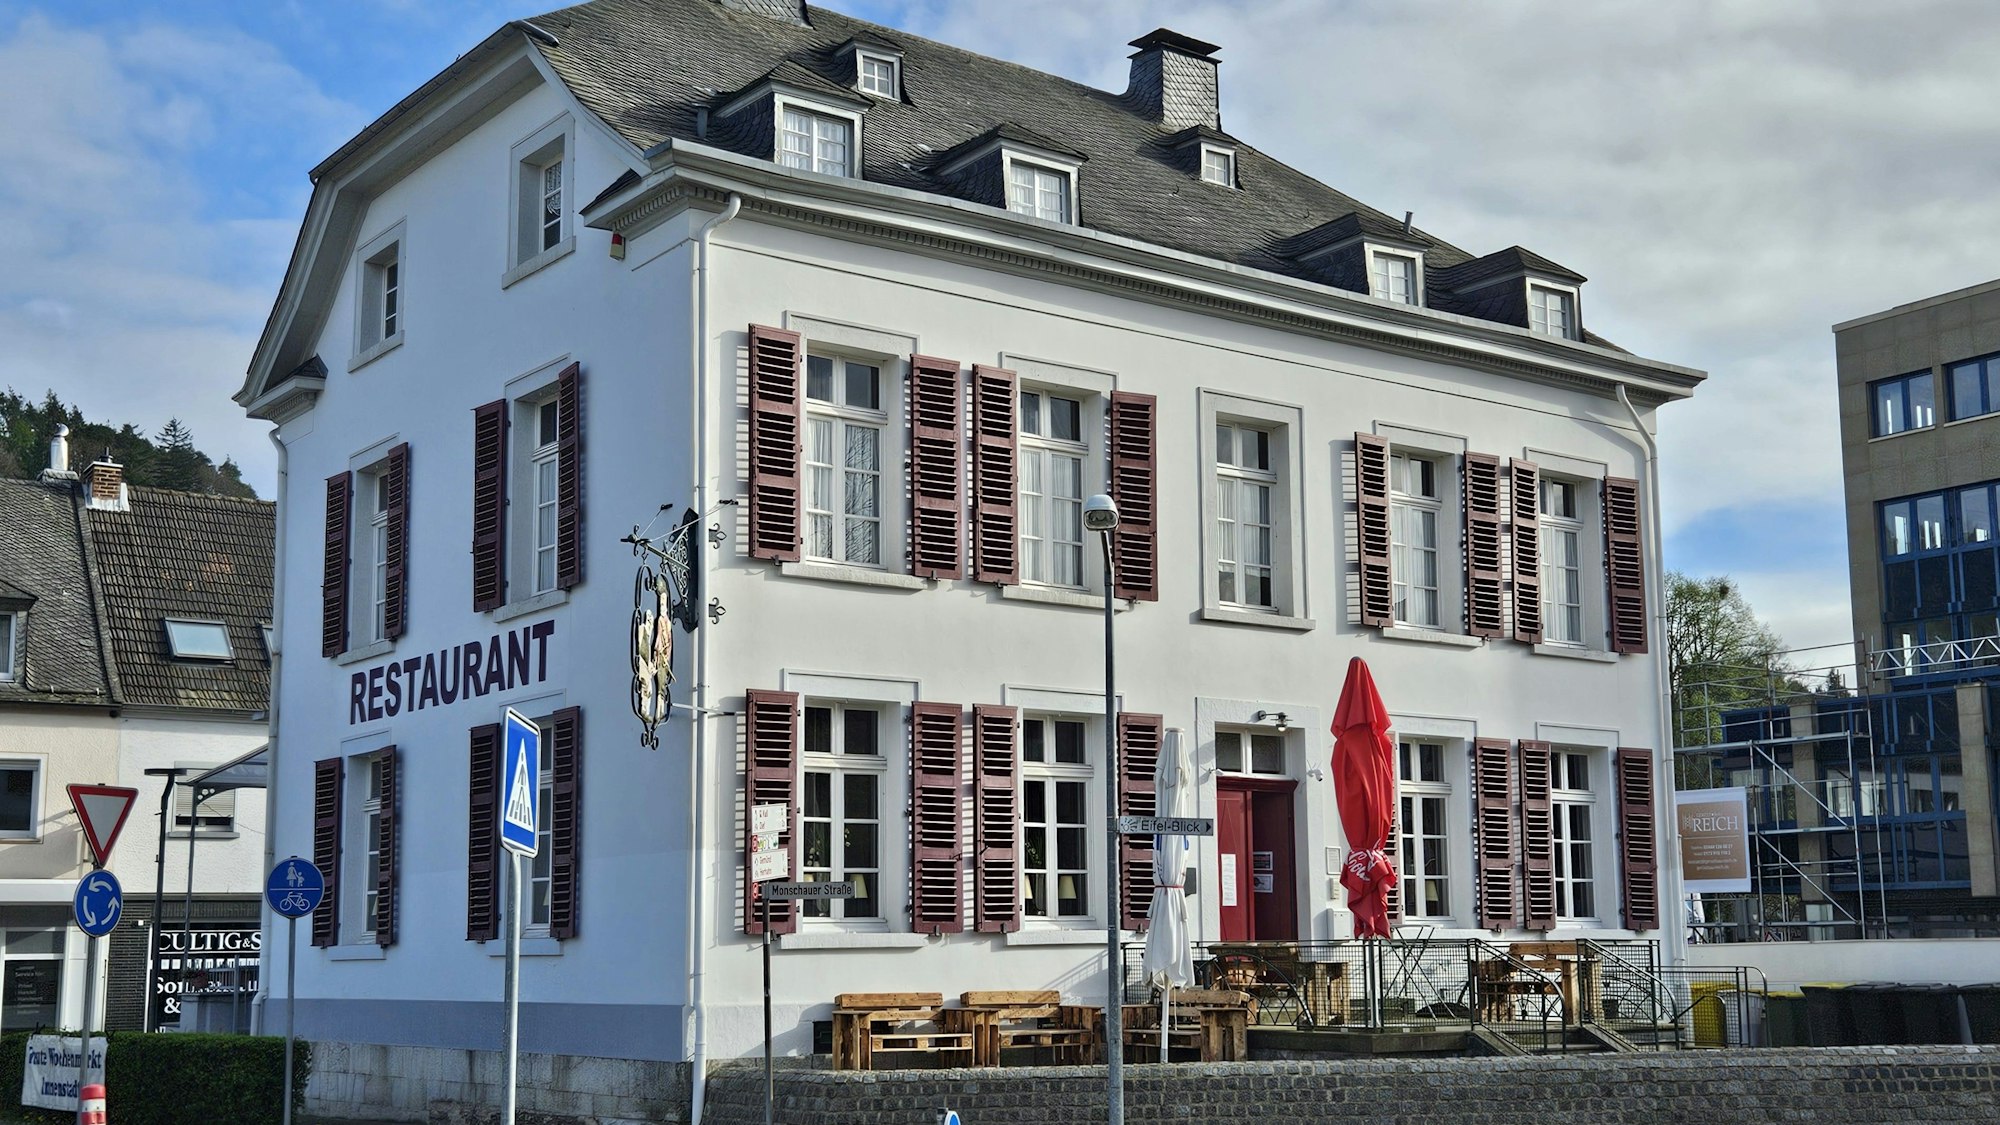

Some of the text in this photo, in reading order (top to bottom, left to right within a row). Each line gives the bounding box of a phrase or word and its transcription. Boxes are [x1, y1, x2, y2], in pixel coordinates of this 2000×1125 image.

[350, 619, 555, 725] RESTAURANT
[1141, 820, 1200, 832] Eifel-Blick
[1692, 815, 1738, 832] REICH
[771, 884, 852, 895] Monschauer Straße
[48, 1047, 102, 1069] Wochenmrkt
[41, 1076, 80, 1098] Innenstad
